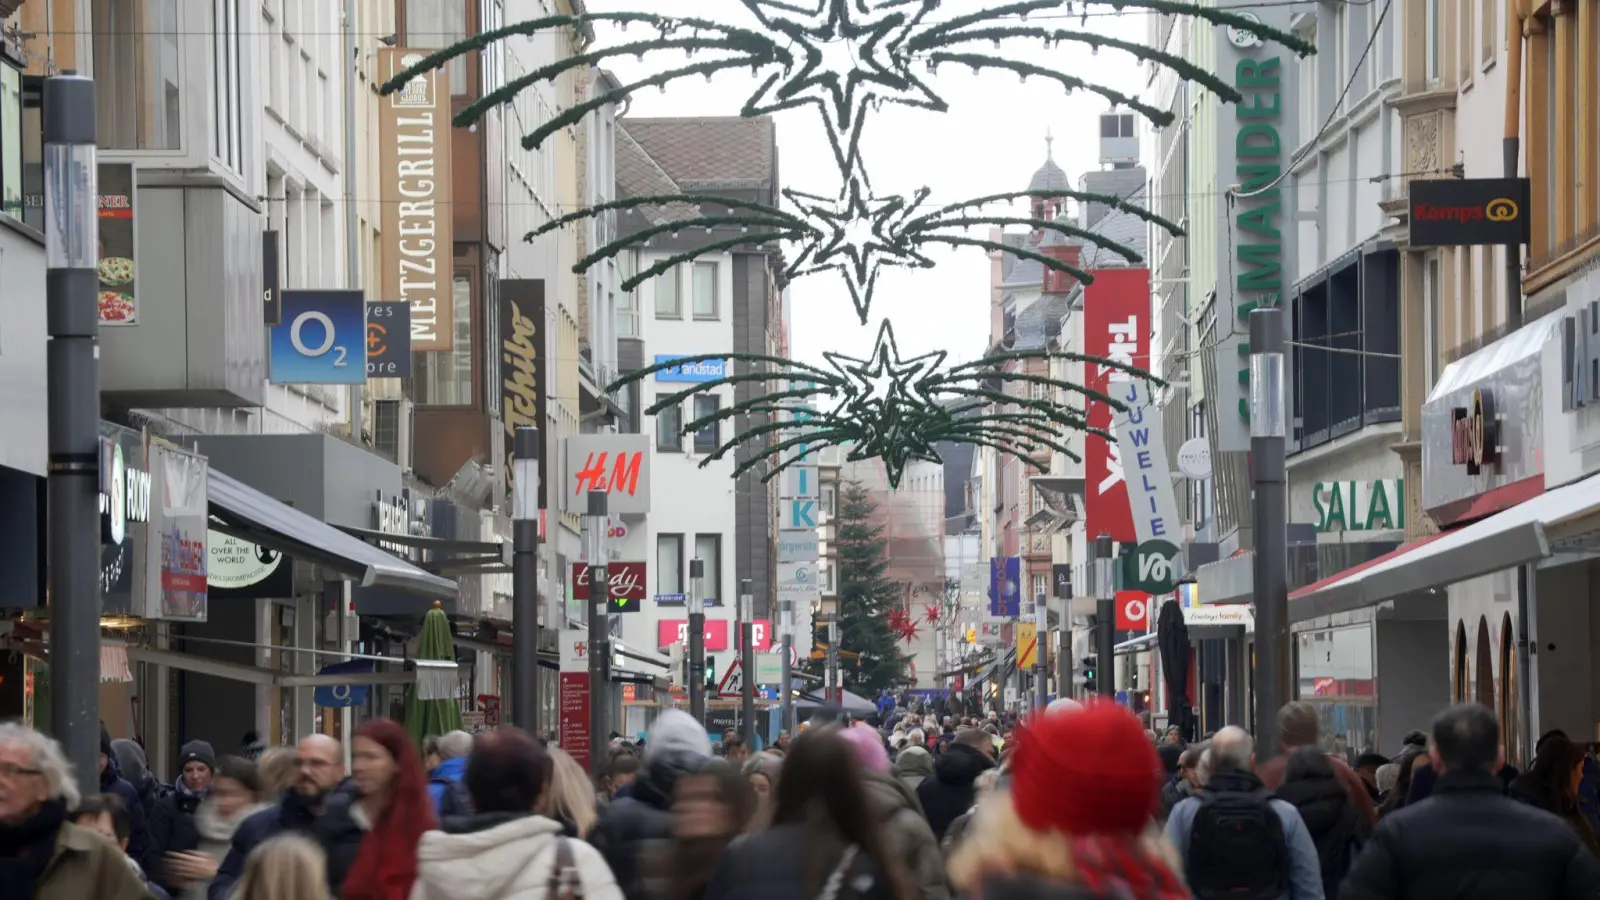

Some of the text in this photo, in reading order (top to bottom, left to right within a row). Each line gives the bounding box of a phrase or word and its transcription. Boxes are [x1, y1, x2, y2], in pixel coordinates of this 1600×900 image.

[397, 112, 437, 342] METZGERGRILL
[1236, 56, 1282, 421] AMANDER
[1414, 203, 1484, 224] Kamps
[290, 310, 348, 367] O2
[503, 300, 537, 438] Tchibo
[575, 451, 643, 497] H&M
[210, 547, 250, 555] OVER THE
[216, 556, 246, 564] WORLD
